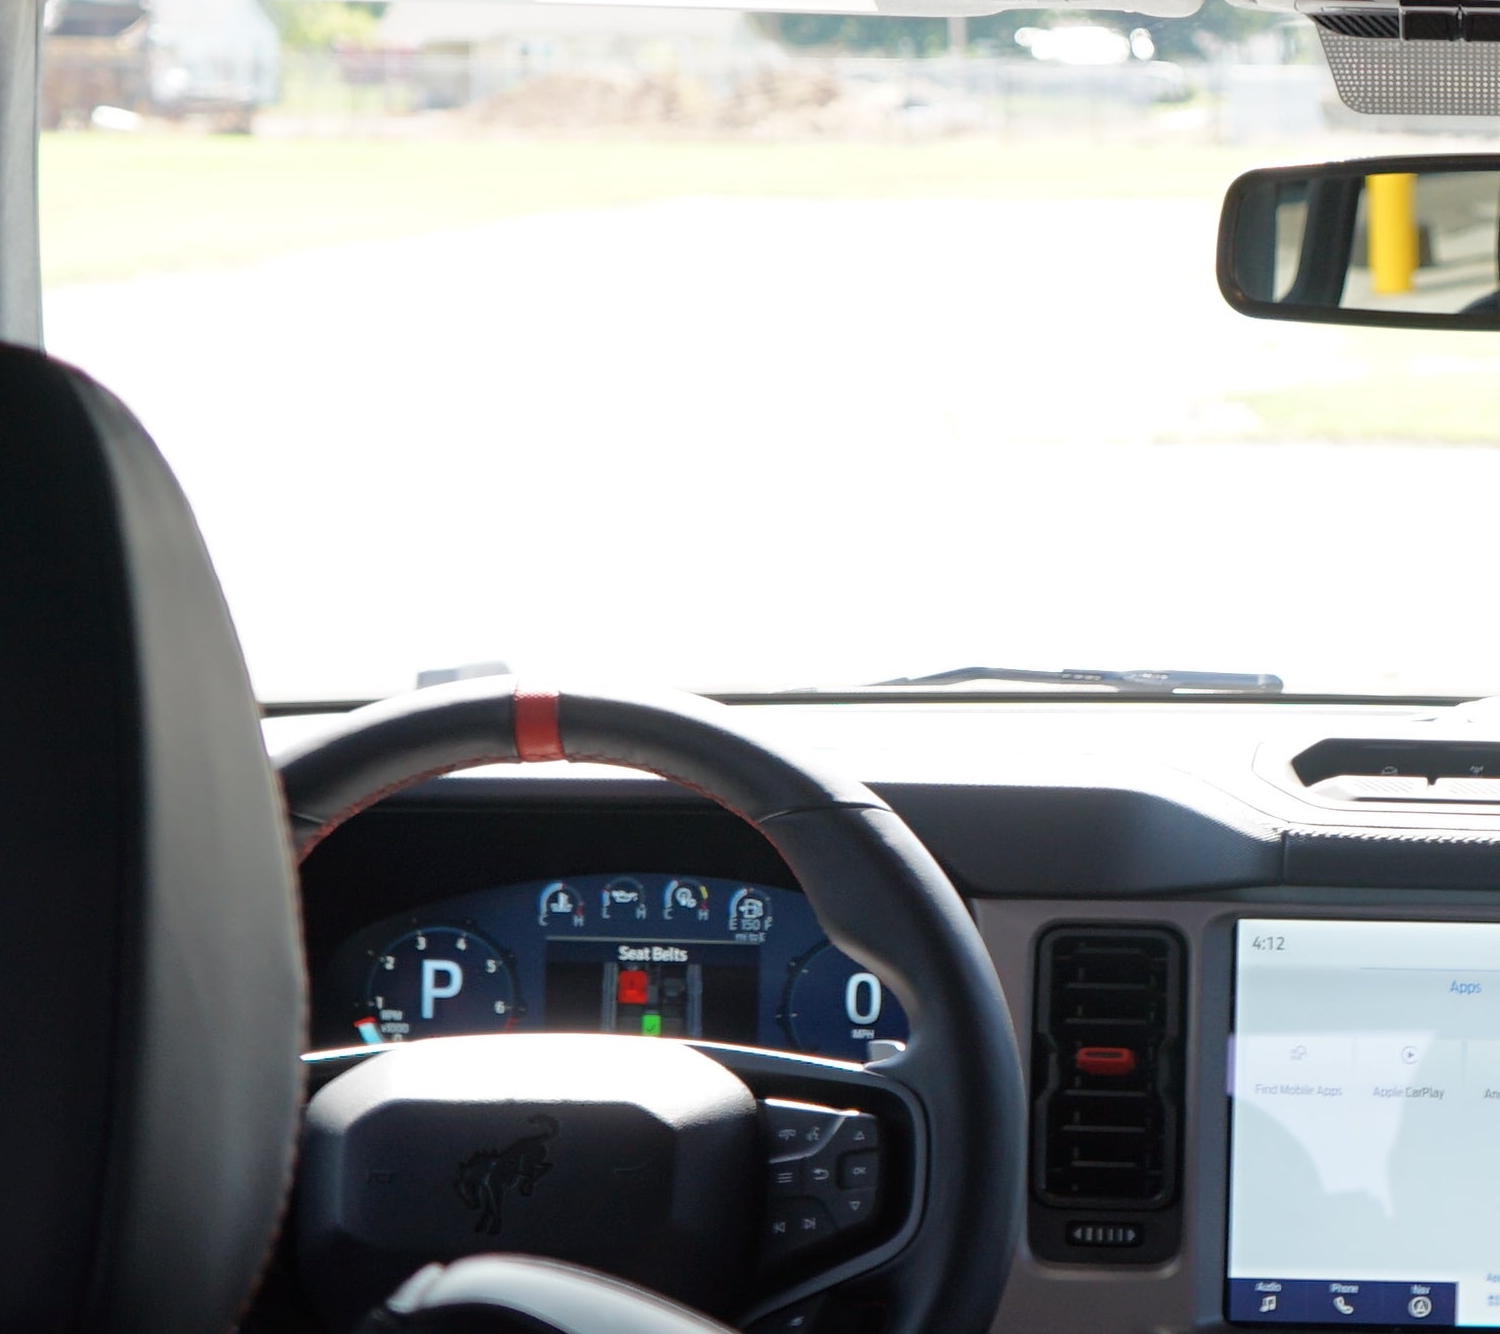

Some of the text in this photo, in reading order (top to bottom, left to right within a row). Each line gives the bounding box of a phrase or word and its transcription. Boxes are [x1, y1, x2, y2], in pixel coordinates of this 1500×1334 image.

[416, 936, 427, 951] 3
[456, 937, 467, 951] 4
[1252, 936, 1285, 951] 4:12
[618, 945, 688, 962] Seat Belts
[384, 955, 395, 971] 2
[485, 959, 497, 974] 5
[421, 958, 464, 1019] P
[1450, 979, 1482, 995] Apps
[845, 972, 882, 1025] 0
[494, 1000, 506, 1015] 6
[852, 1029, 875, 1039] MPH
[1255, 1083, 1343, 1098] Find Mobile Apps
[1372, 1085, 1445, 1100] Apple CarPlay
[1255, 1282, 1282, 1293] Audio
[1330, 1283, 1359, 1294] Phone
[1411, 1284, 1431, 1295] Nav
